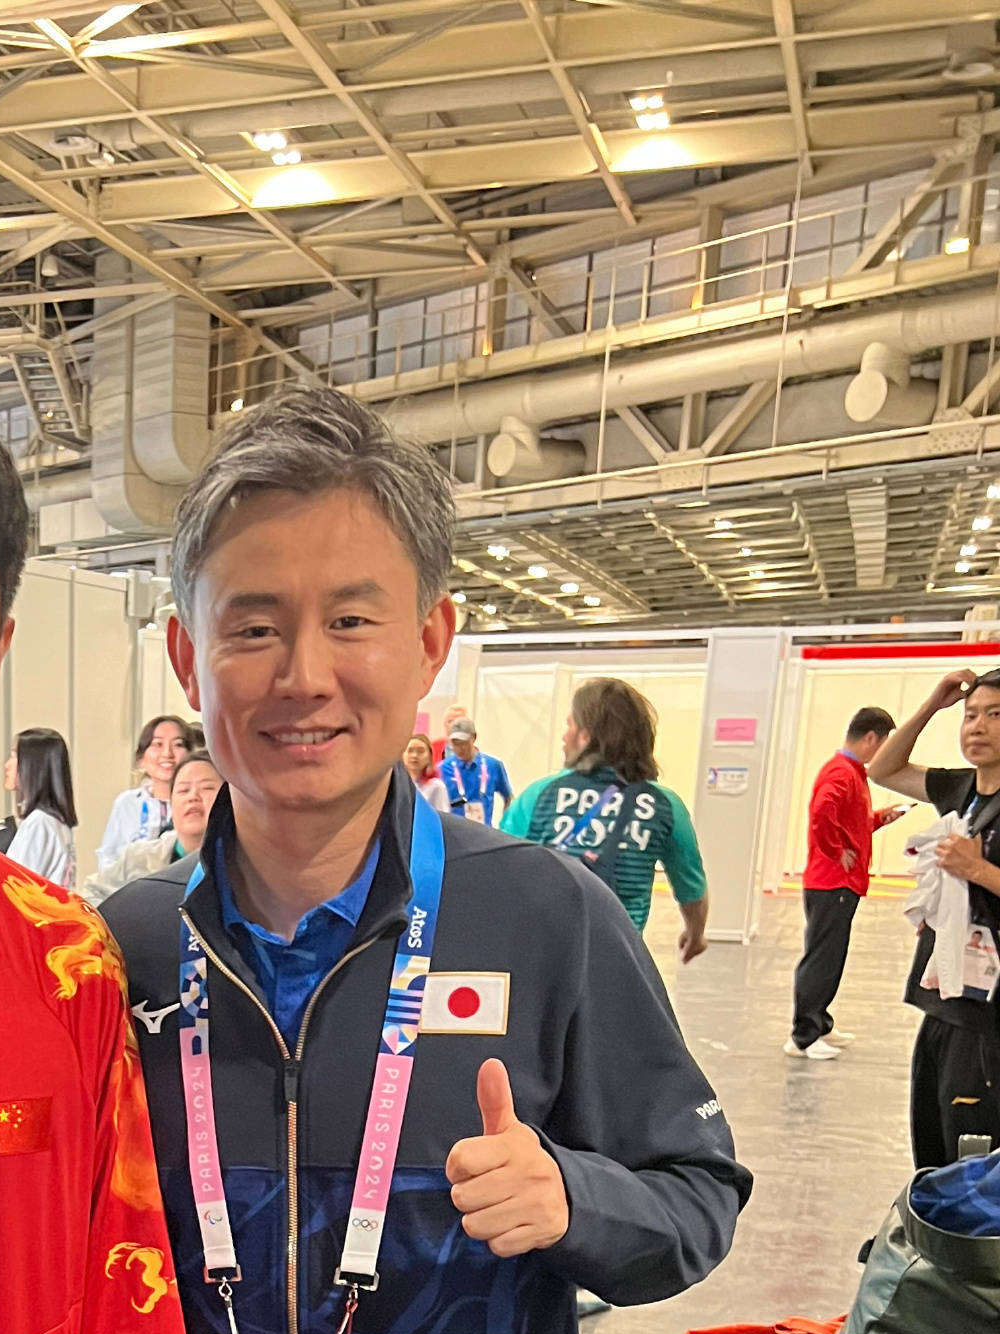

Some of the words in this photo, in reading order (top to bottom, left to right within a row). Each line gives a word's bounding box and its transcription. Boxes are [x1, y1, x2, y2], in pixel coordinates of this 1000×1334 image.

[553, 815, 651, 851] 204
[556, 787, 656, 820] PARS
[190, 1065, 207, 1124] 2024
[373, 1066, 401, 1134] PARIS
[195, 1130, 216, 1193] PARIS
[363, 1141, 387, 1200] 2024
